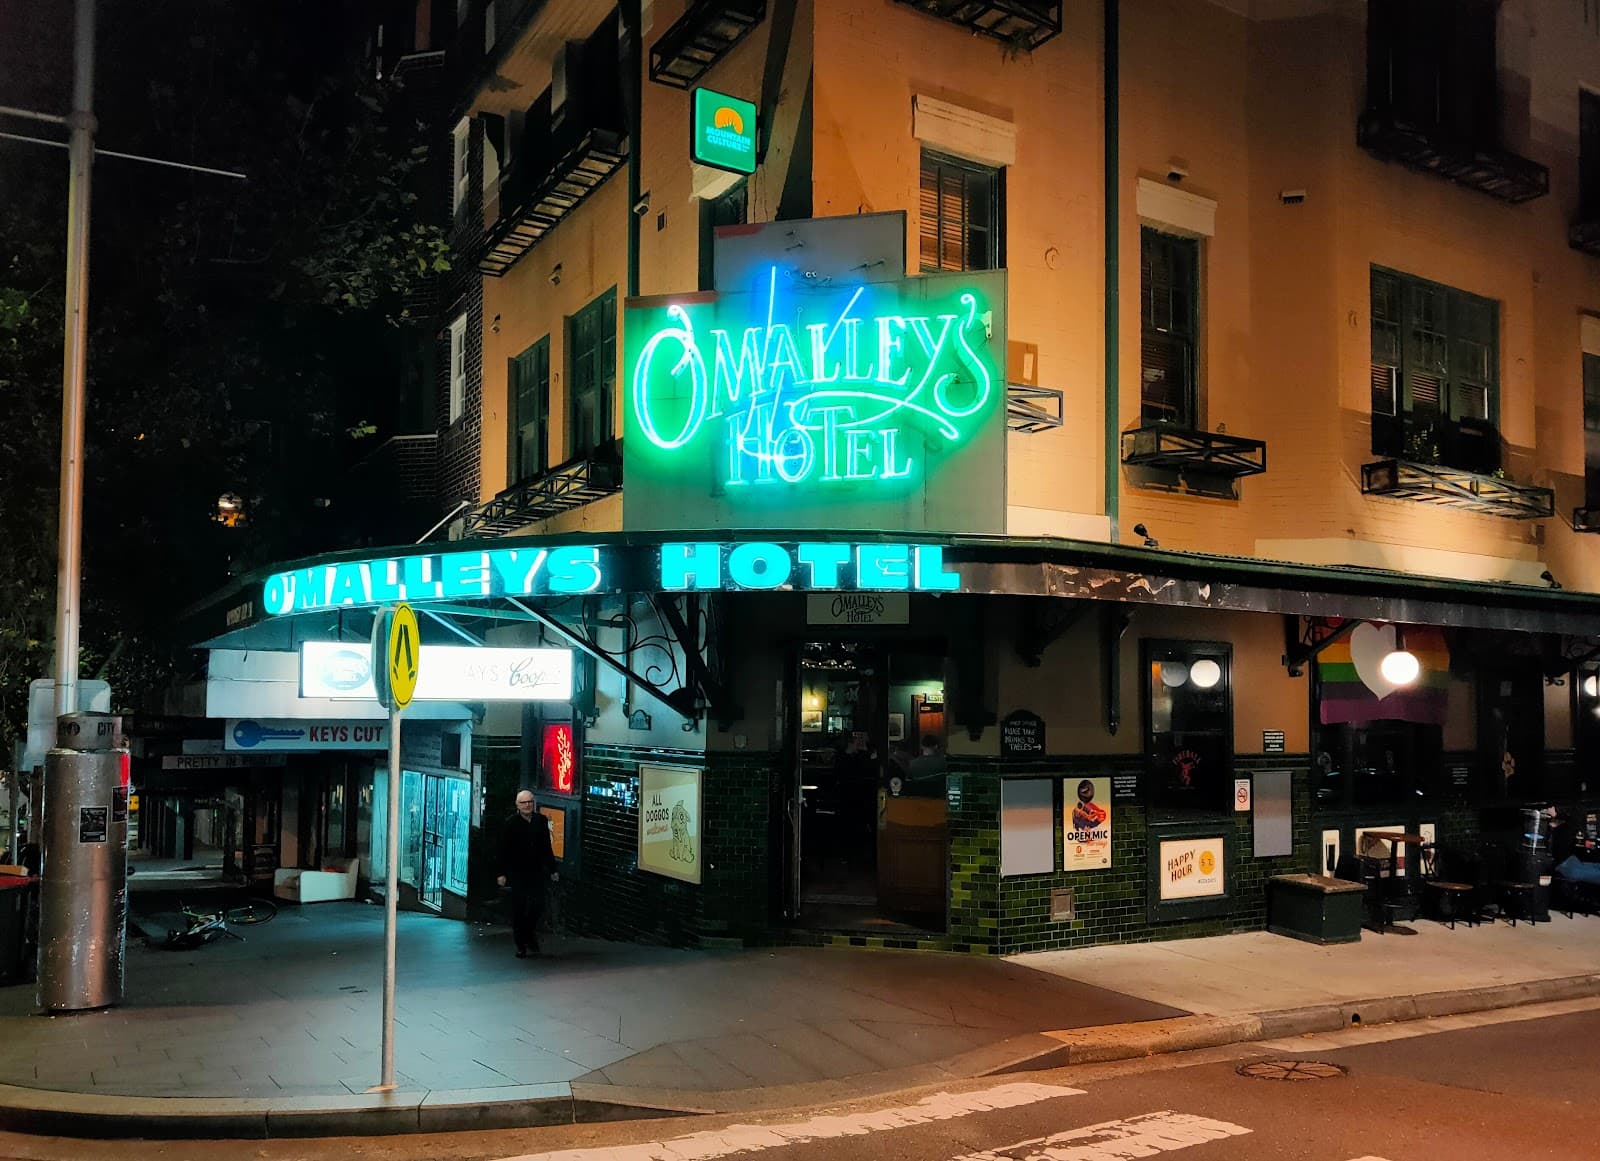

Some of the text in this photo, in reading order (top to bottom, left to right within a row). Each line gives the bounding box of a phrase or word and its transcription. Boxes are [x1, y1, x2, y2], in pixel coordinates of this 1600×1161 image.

[706, 126, 751, 145] MOUNTAIN
[707, 135, 742, 151] CULTURE
[726, 404, 912, 486] HOTEL
[661, 542, 961, 590] HOTEL
[846, 611, 873, 622] HOTEL
[309, 726, 383, 742] KEYS CUT
[177, 756, 219, 768] PRETTY
[652, 792, 662, 806] ALL
[646, 808, 670, 822] DOGGOS
[1067, 830, 1108, 841] OPEN MIC
[1168, 849, 1196, 871] HAPPY
[1171, 864, 1193, 882] HOUR
